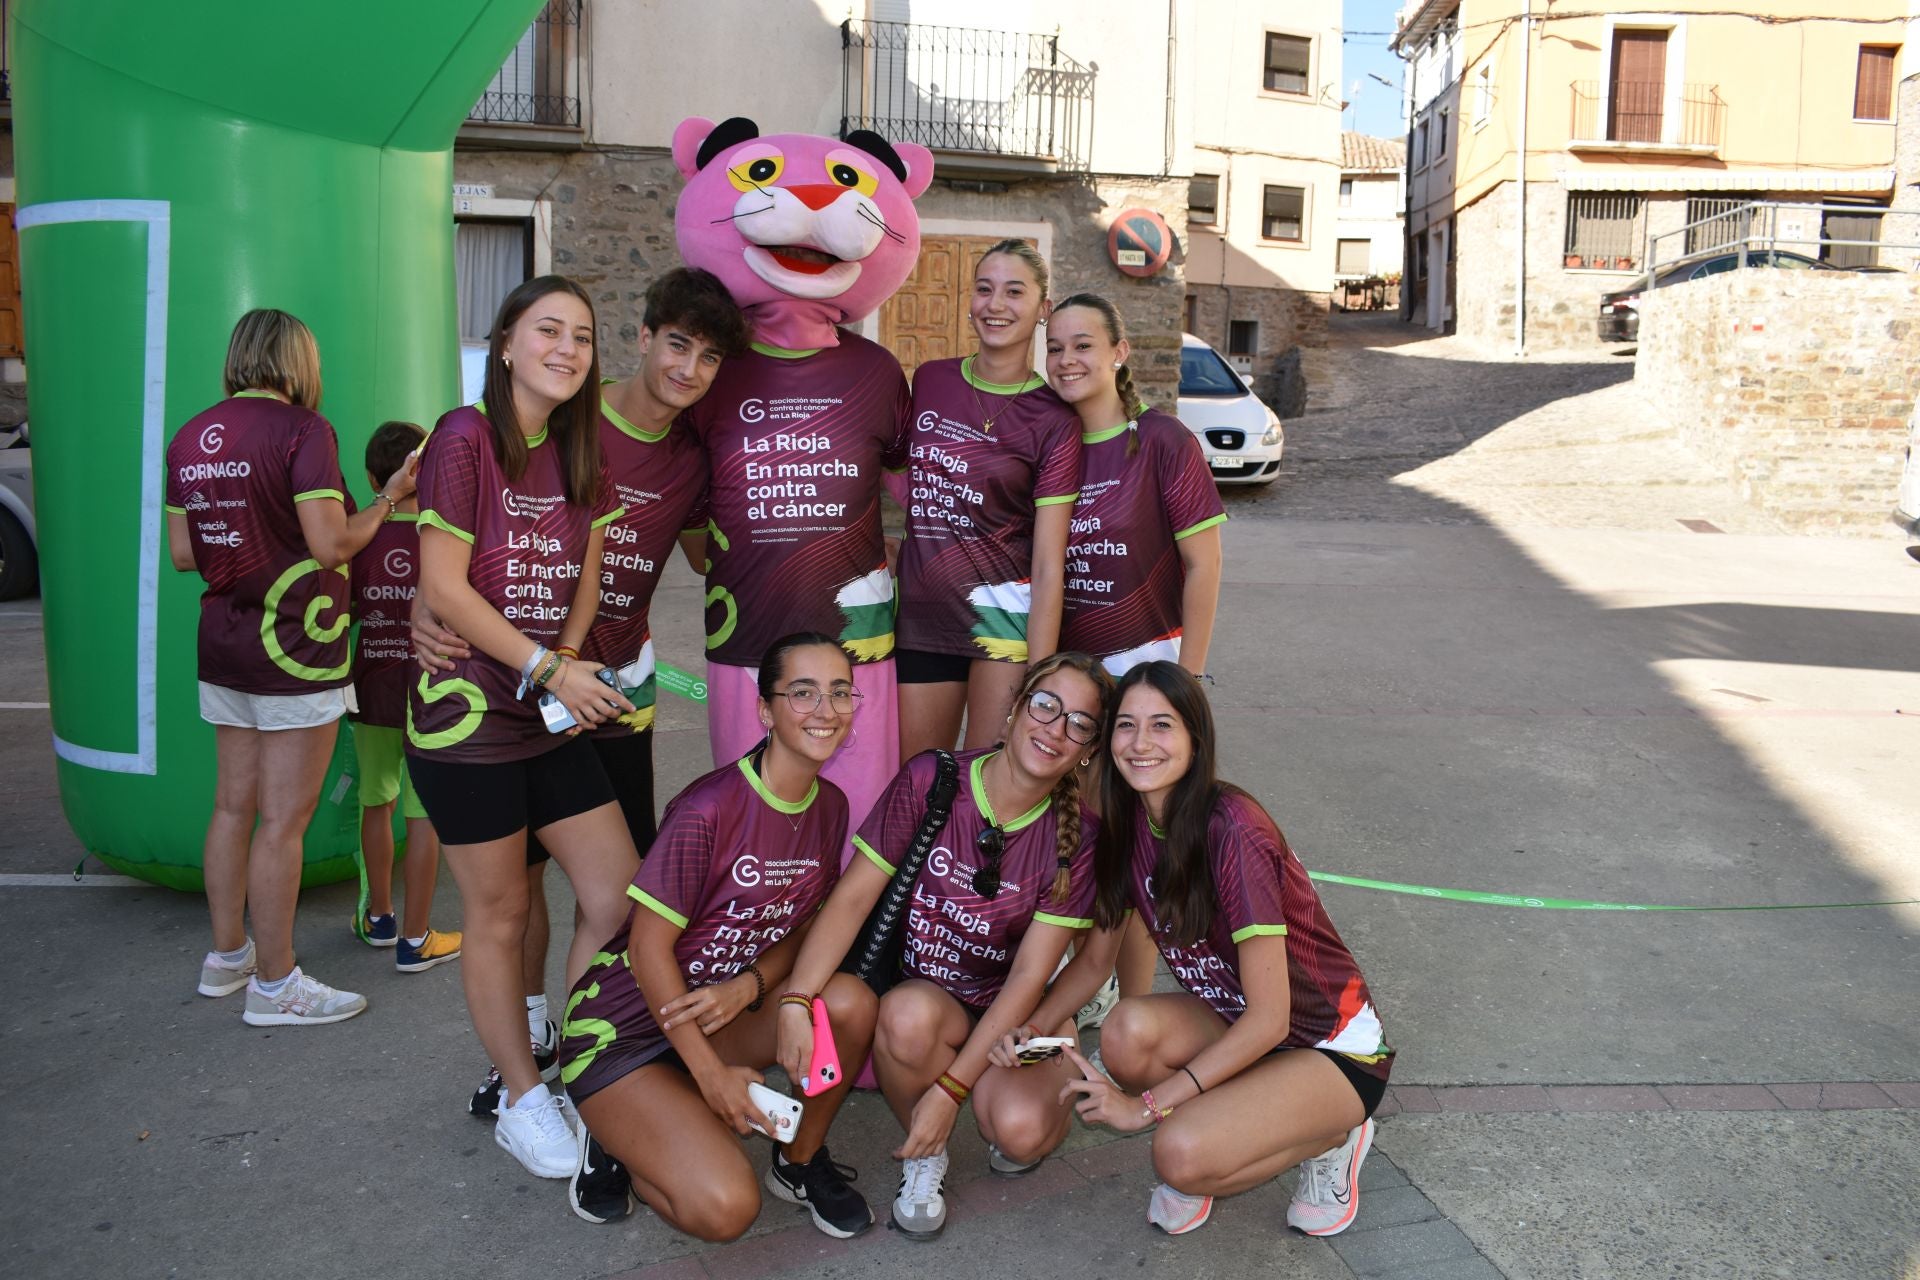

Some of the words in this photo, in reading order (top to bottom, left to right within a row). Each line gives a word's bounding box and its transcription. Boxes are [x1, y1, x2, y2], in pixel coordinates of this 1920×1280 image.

[463, 201, 468, 210] 2
[769, 397, 809, 405] asociación
[809, 397, 843, 405] española
[791, 412, 810, 420] Rioja
[942, 418, 972, 432] asociación
[938, 423, 957, 433] contra
[943, 430, 951, 438] La
[743, 436, 770, 454] La
[775, 432, 831, 454] Rioja
[910, 442, 925, 459] La
[928, 446, 968, 474] Rioja
[180, 461, 251, 483] CORNAGO
[746, 462, 772, 480] En
[778, 459, 859, 478] marcha
[746, 480, 817, 500] contra
[747, 502, 767, 520] el
[772, 499, 847, 519] cáncer
[911, 501, 926, 517] el
[508, 531, 530, 549] La
[604, 521, 638, 544] ioja
[507, 559, 527, 577] En
[602, 552, 654, 573] archa
[774, 878, 782, 886] La
[949, 876, 959, 885] en
[959, 880, 968, 889] La
[726, 900, 756, 920] La
[915, 883, 937, 909] La
[941, 899, 991, 936] Rioja
[908, 908, 931, 934] En
[933, 924, 1006, 961] marcha
[906, 931, 961, 964] contra
[904, 949, 916, 968] el
